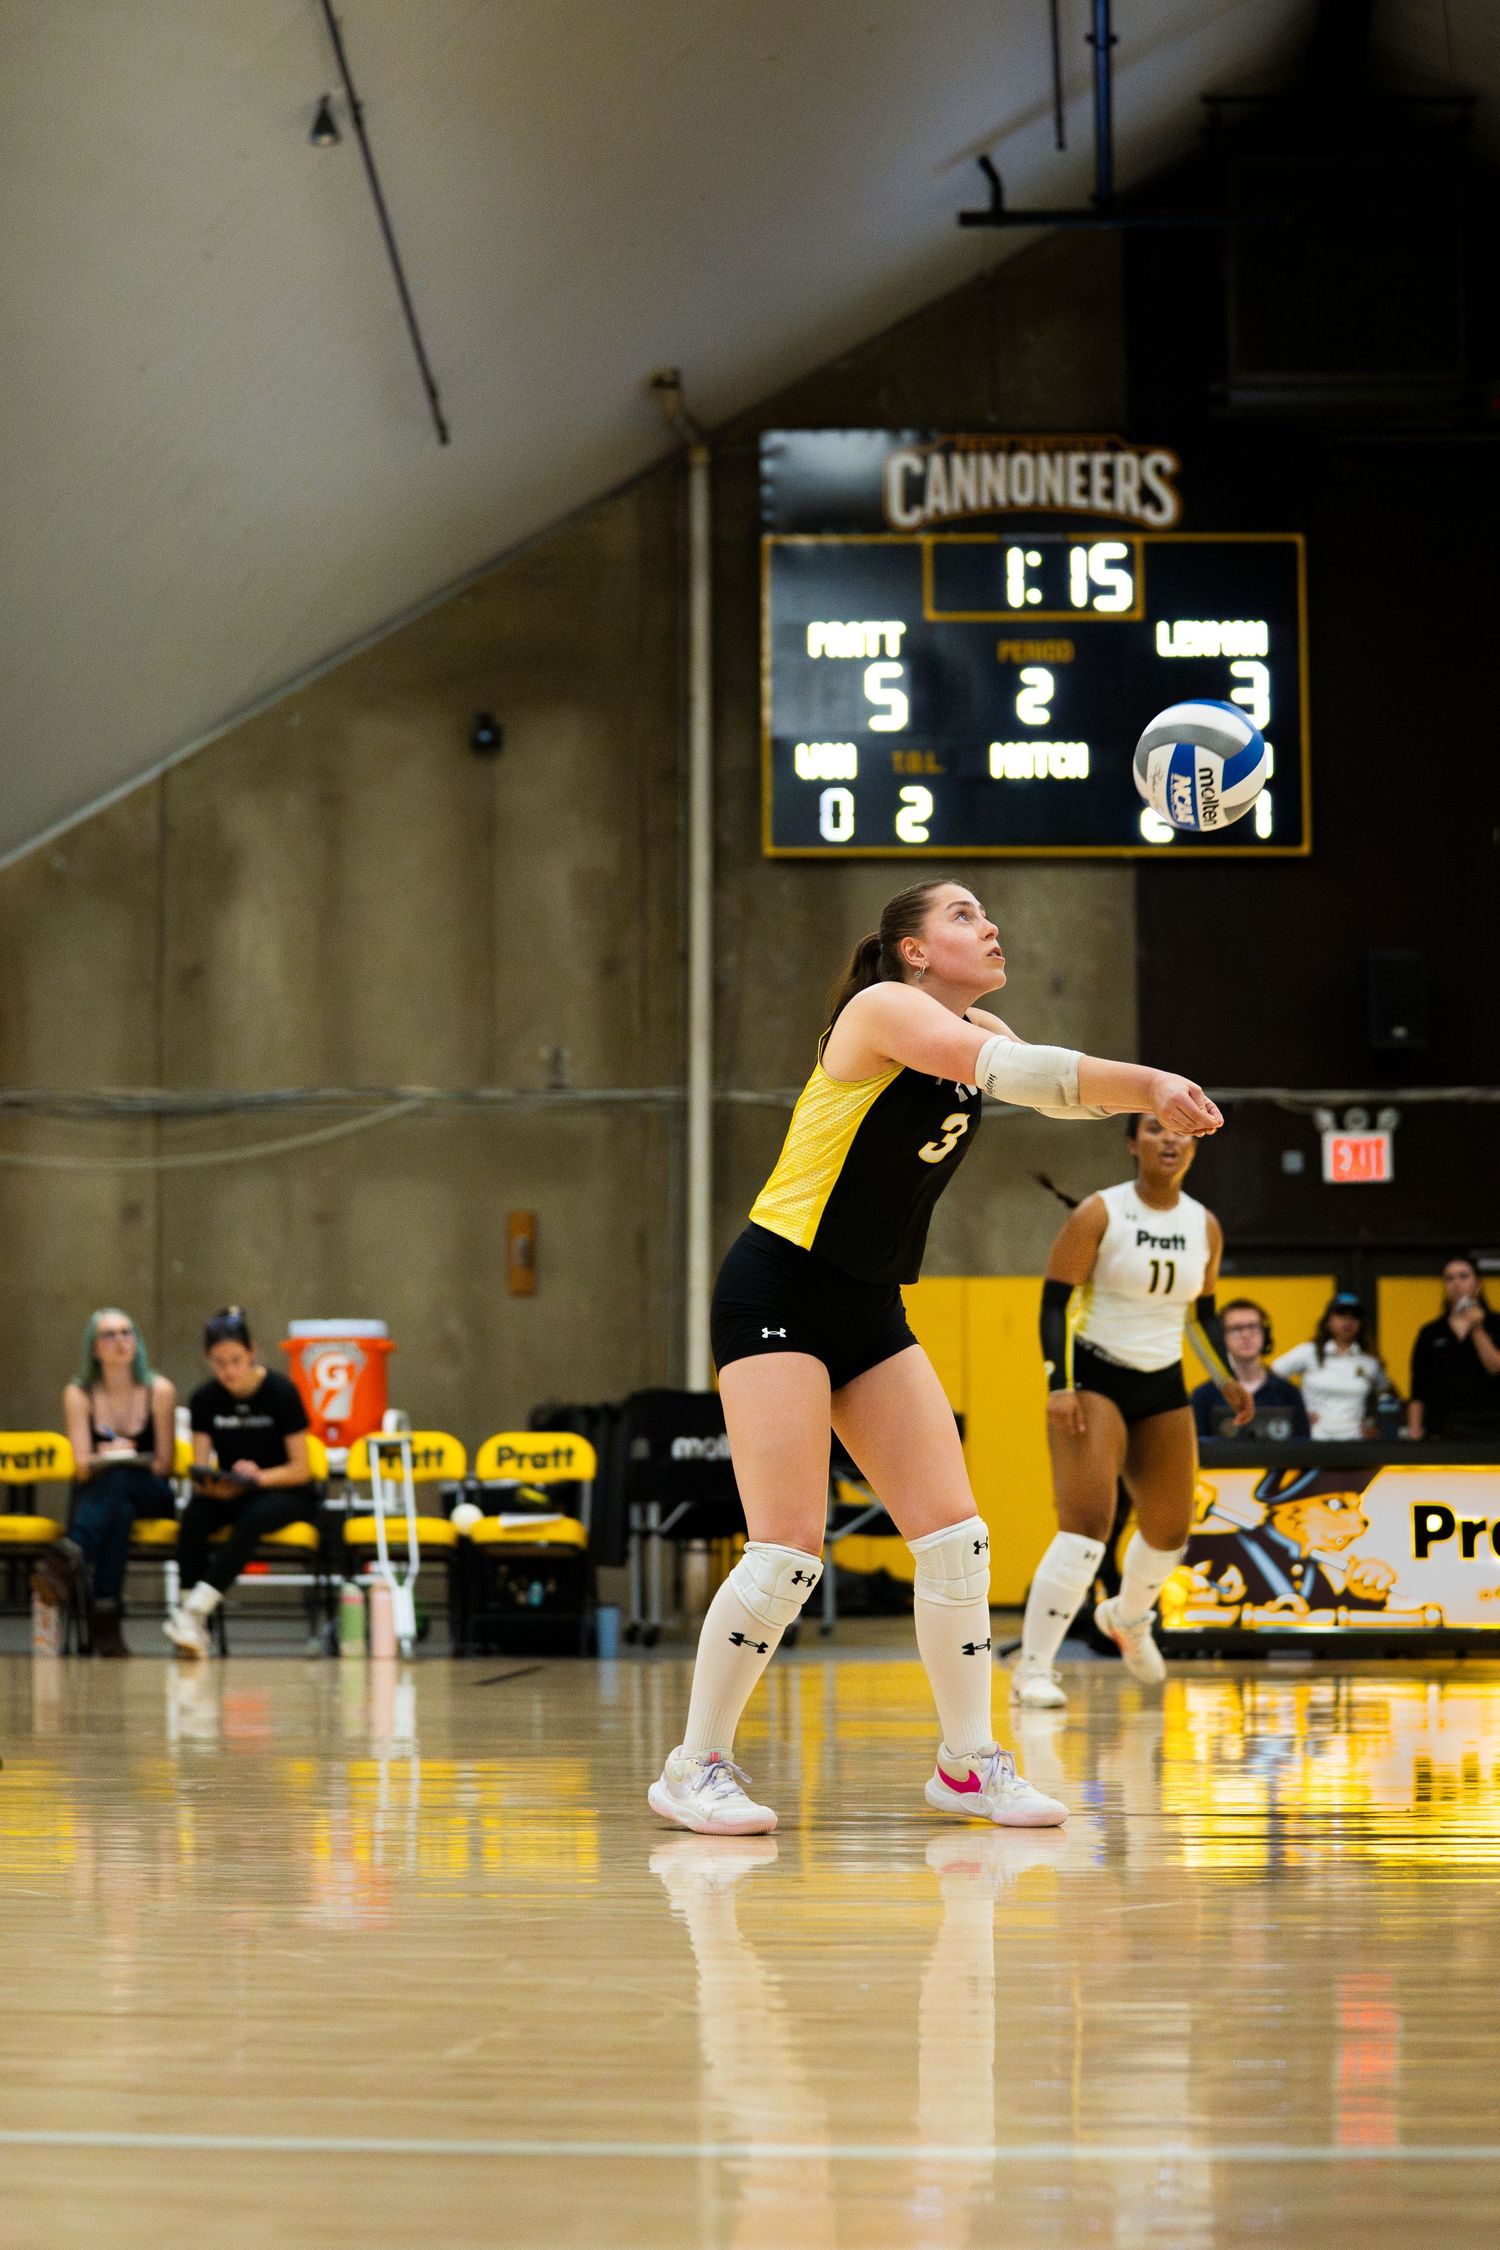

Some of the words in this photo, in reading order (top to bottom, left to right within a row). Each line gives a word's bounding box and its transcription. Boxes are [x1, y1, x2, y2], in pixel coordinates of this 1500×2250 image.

[886, 449, 1181, 527] CANNONEERS
[864, 661, 909, 732] 5
[1016, 667, 1055, 725] 2
[1230, 661, 1271, 730] 3
[819, 787, 854, 842] 0
[895, 785, 933, 843] 2
[1199, 767, 1220, 827] molten
[918, 1113, 970, 1164] 3
[1136, 1229, 1186, 1250] Pratt
[1149, 1259, 1175, 1294] 11
[0, 1446, 56, 1469] ratt
[496, 1446, 574, 1468] Pratt
[671, 1434, 730, 1461] mol
[1412, 1503, 1500, 1559] Pr
